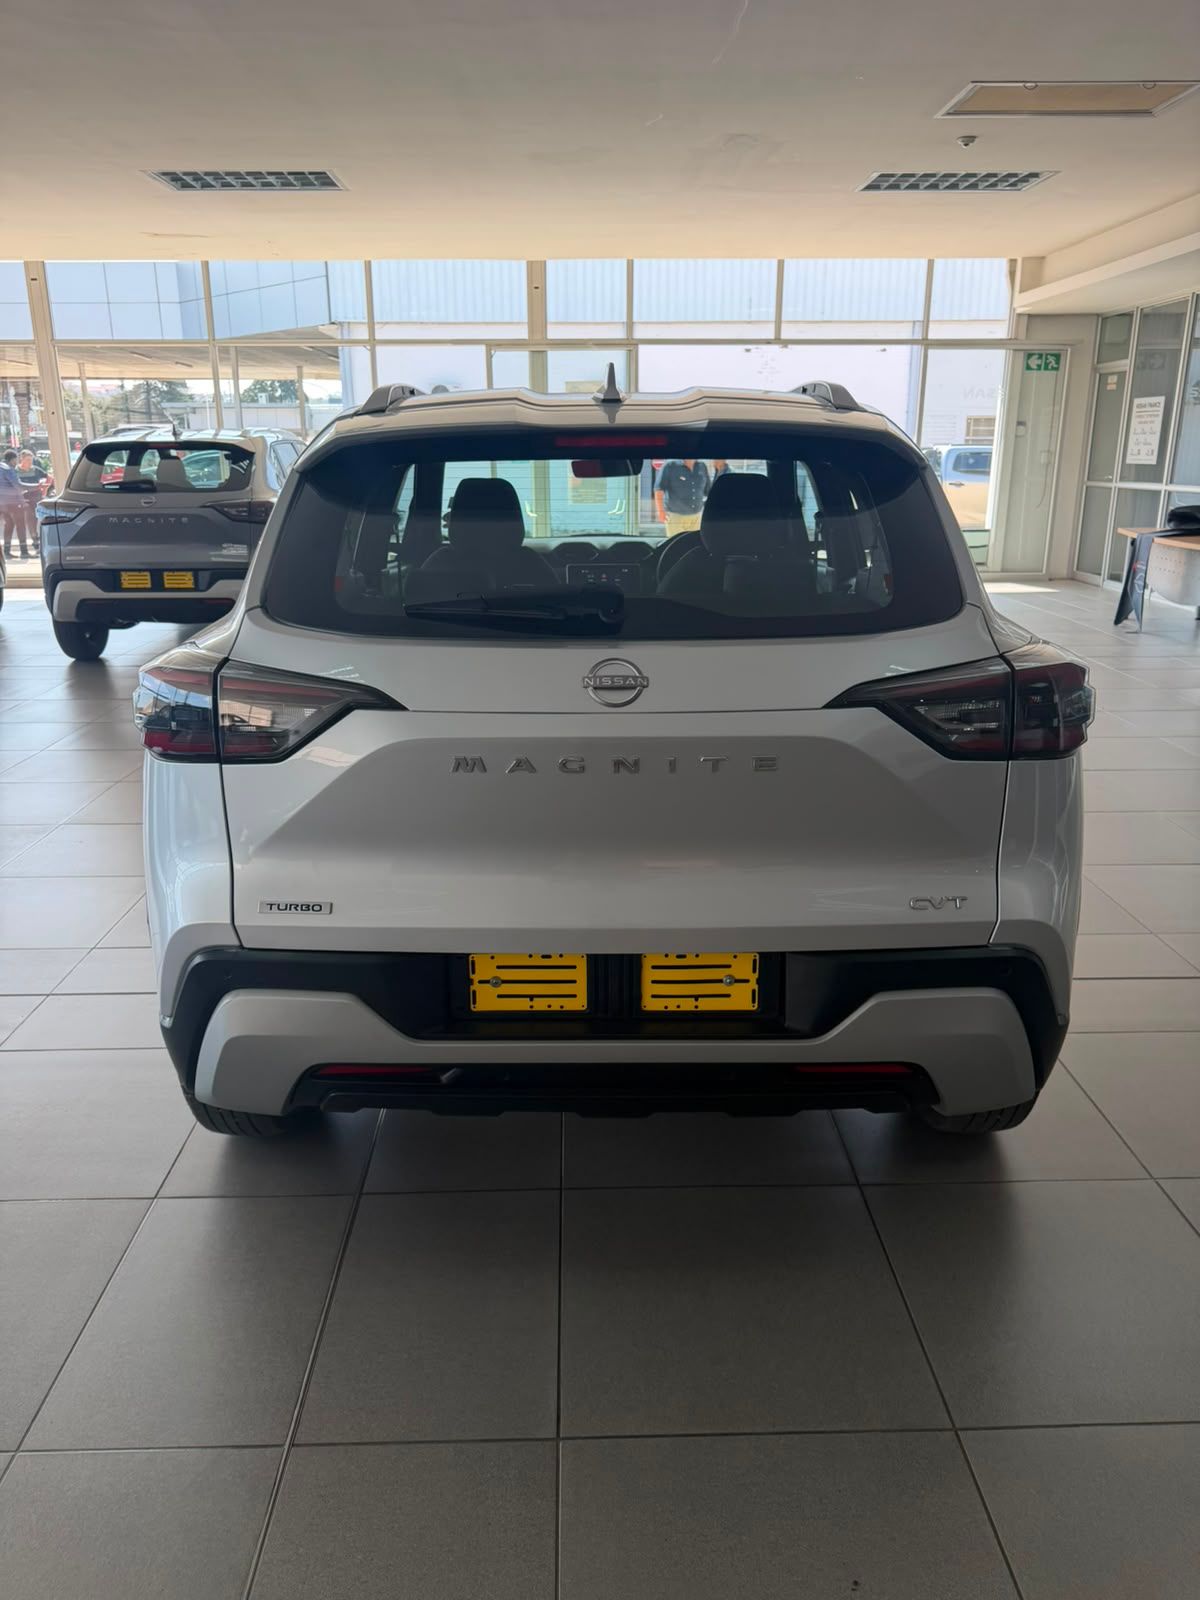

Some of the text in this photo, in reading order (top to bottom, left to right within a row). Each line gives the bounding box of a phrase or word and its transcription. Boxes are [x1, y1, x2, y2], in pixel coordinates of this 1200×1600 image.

[108, 516, 190, 524] MAGNITE
[583, 676, 648, 687] NISSAN
[450, 755, 778, 774] MAGNITE
[265, 902, 323, 913] TURBO
[908, 896, 969, 911] CVT
